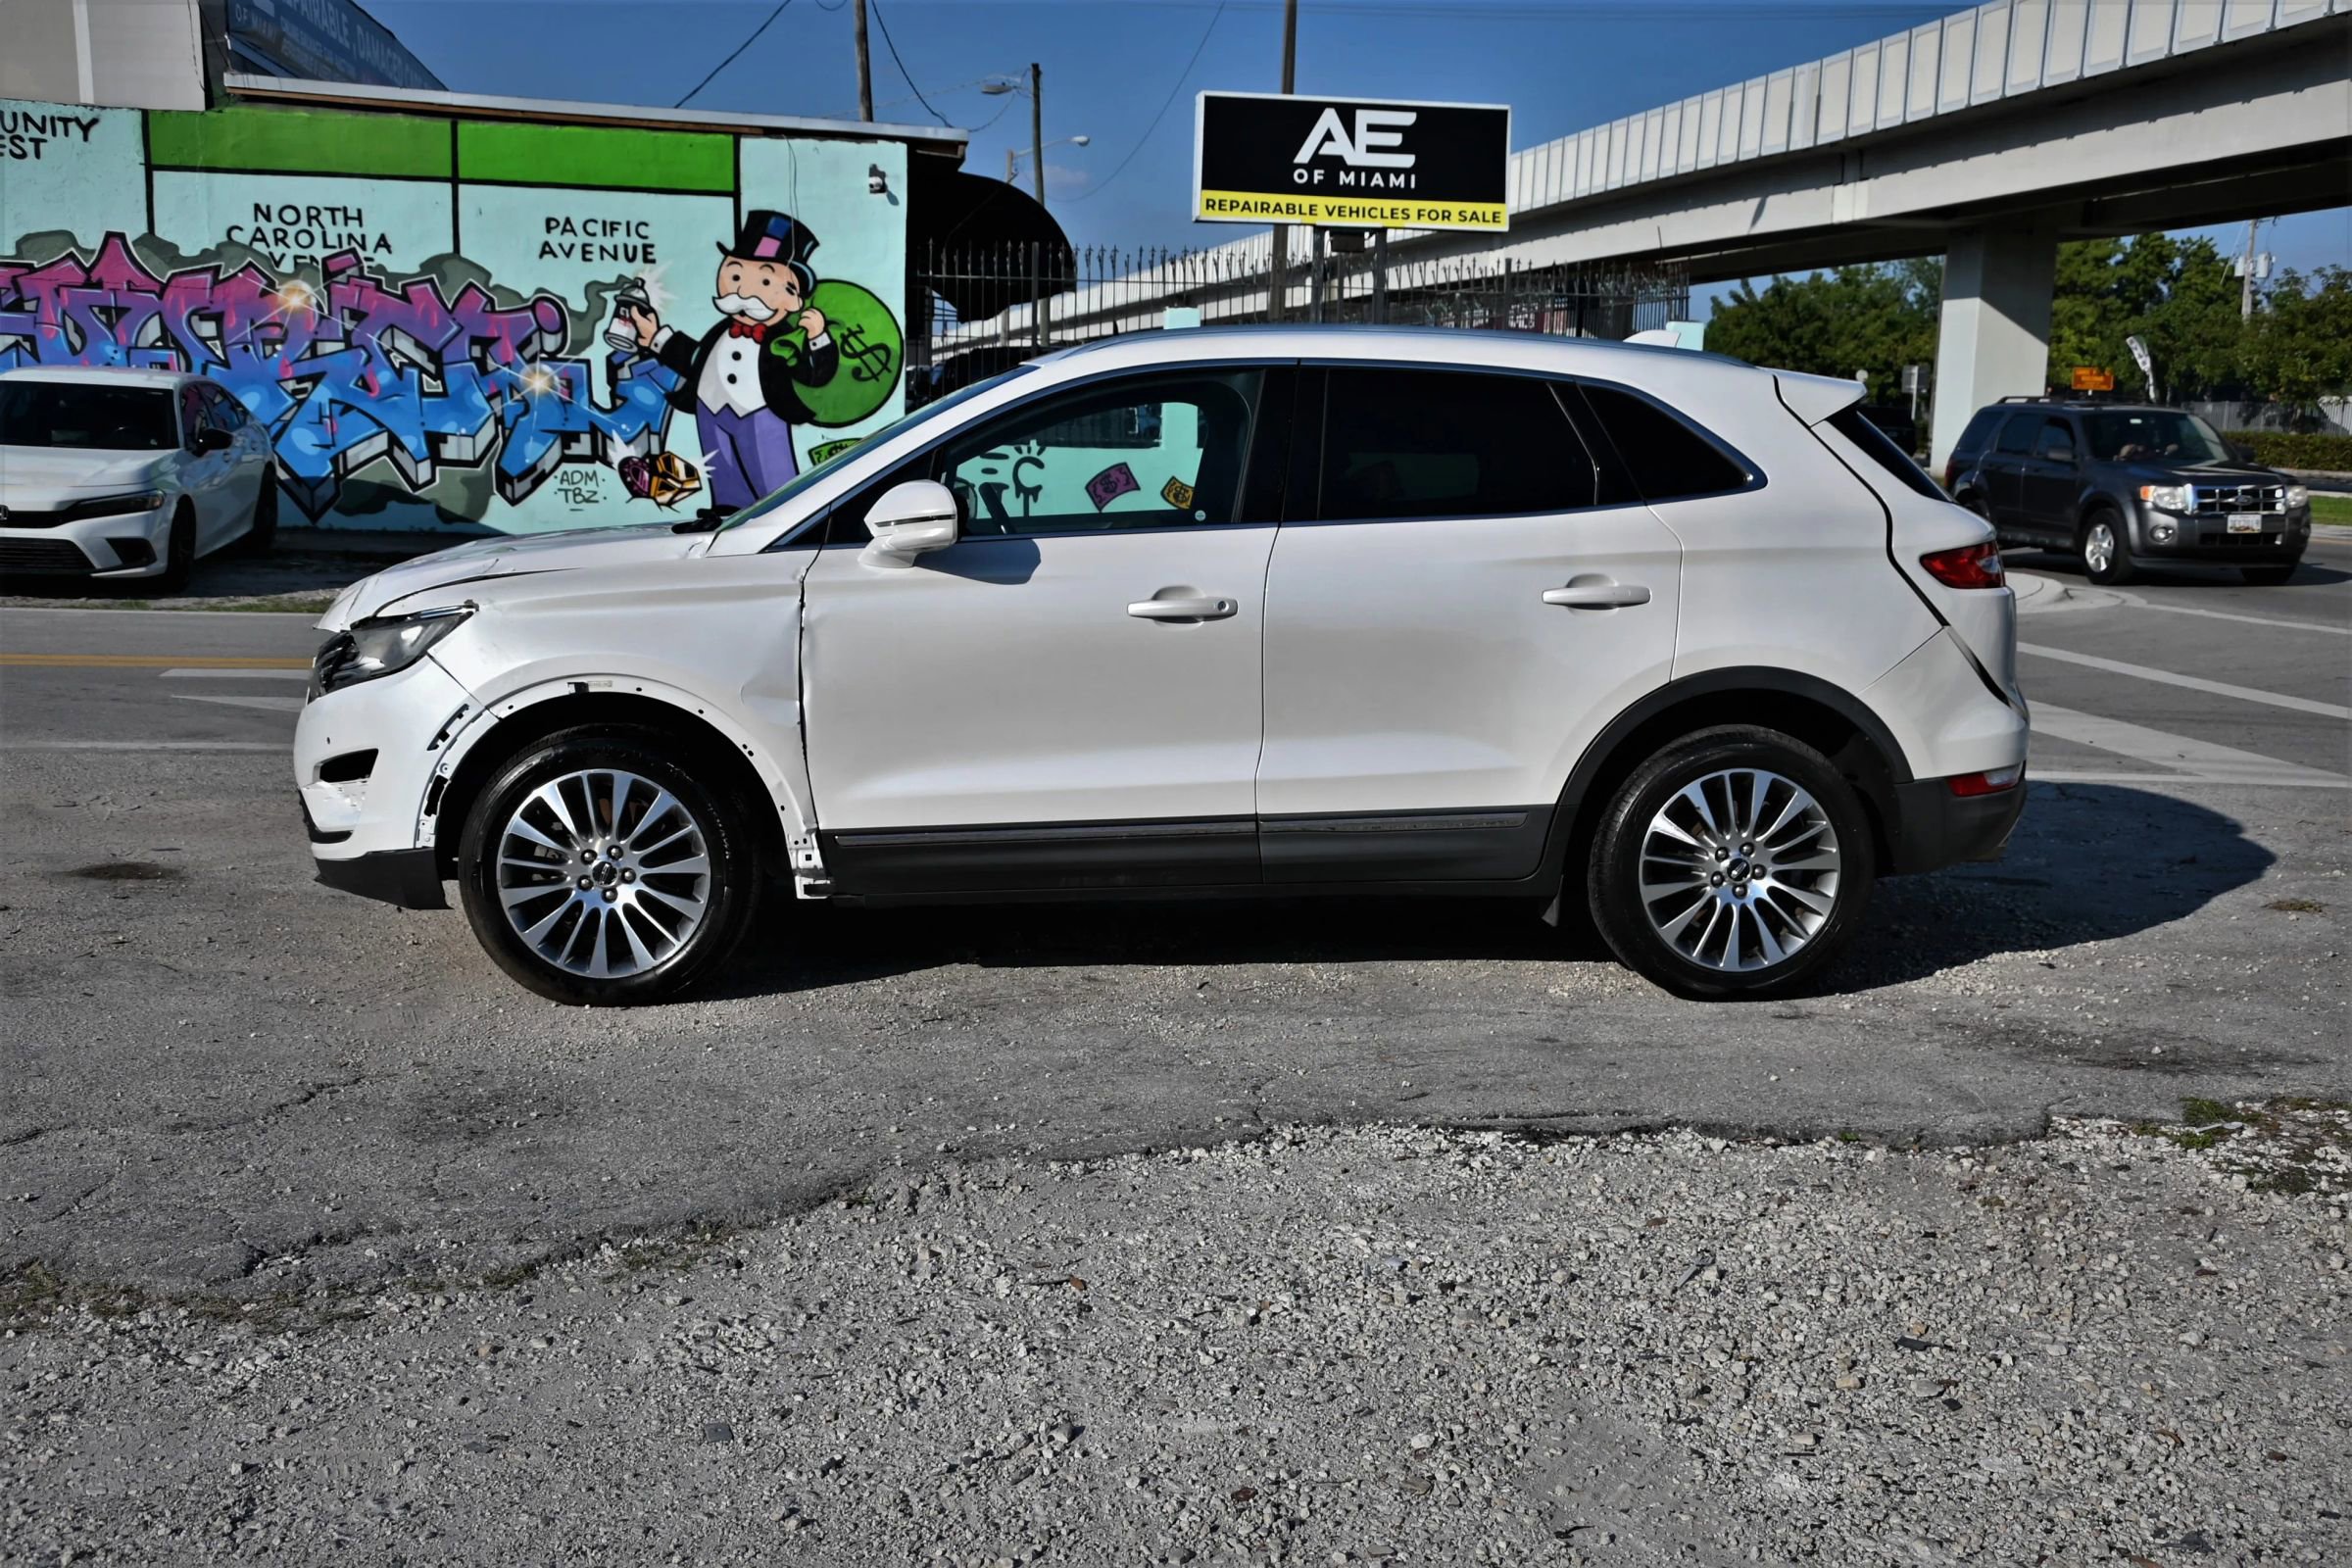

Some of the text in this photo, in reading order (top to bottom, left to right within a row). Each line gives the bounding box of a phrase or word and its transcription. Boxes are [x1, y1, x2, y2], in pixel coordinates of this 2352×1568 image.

[0, 110, 100, 142] UNITY
[1293, 107, 1417, 169] AE
[1293, 168, 1416, 189] OF MIAMI
[253, 203, 364, 228] NORTH
[1205, 198, 1501, 223] REPAIRABLE VEHICLES FOR SALE
[225, 225, 393, 255] CAROLINA
[545, 217, 650, 240] PACIFIC
[538, 240, 657, 265] AVENUE
